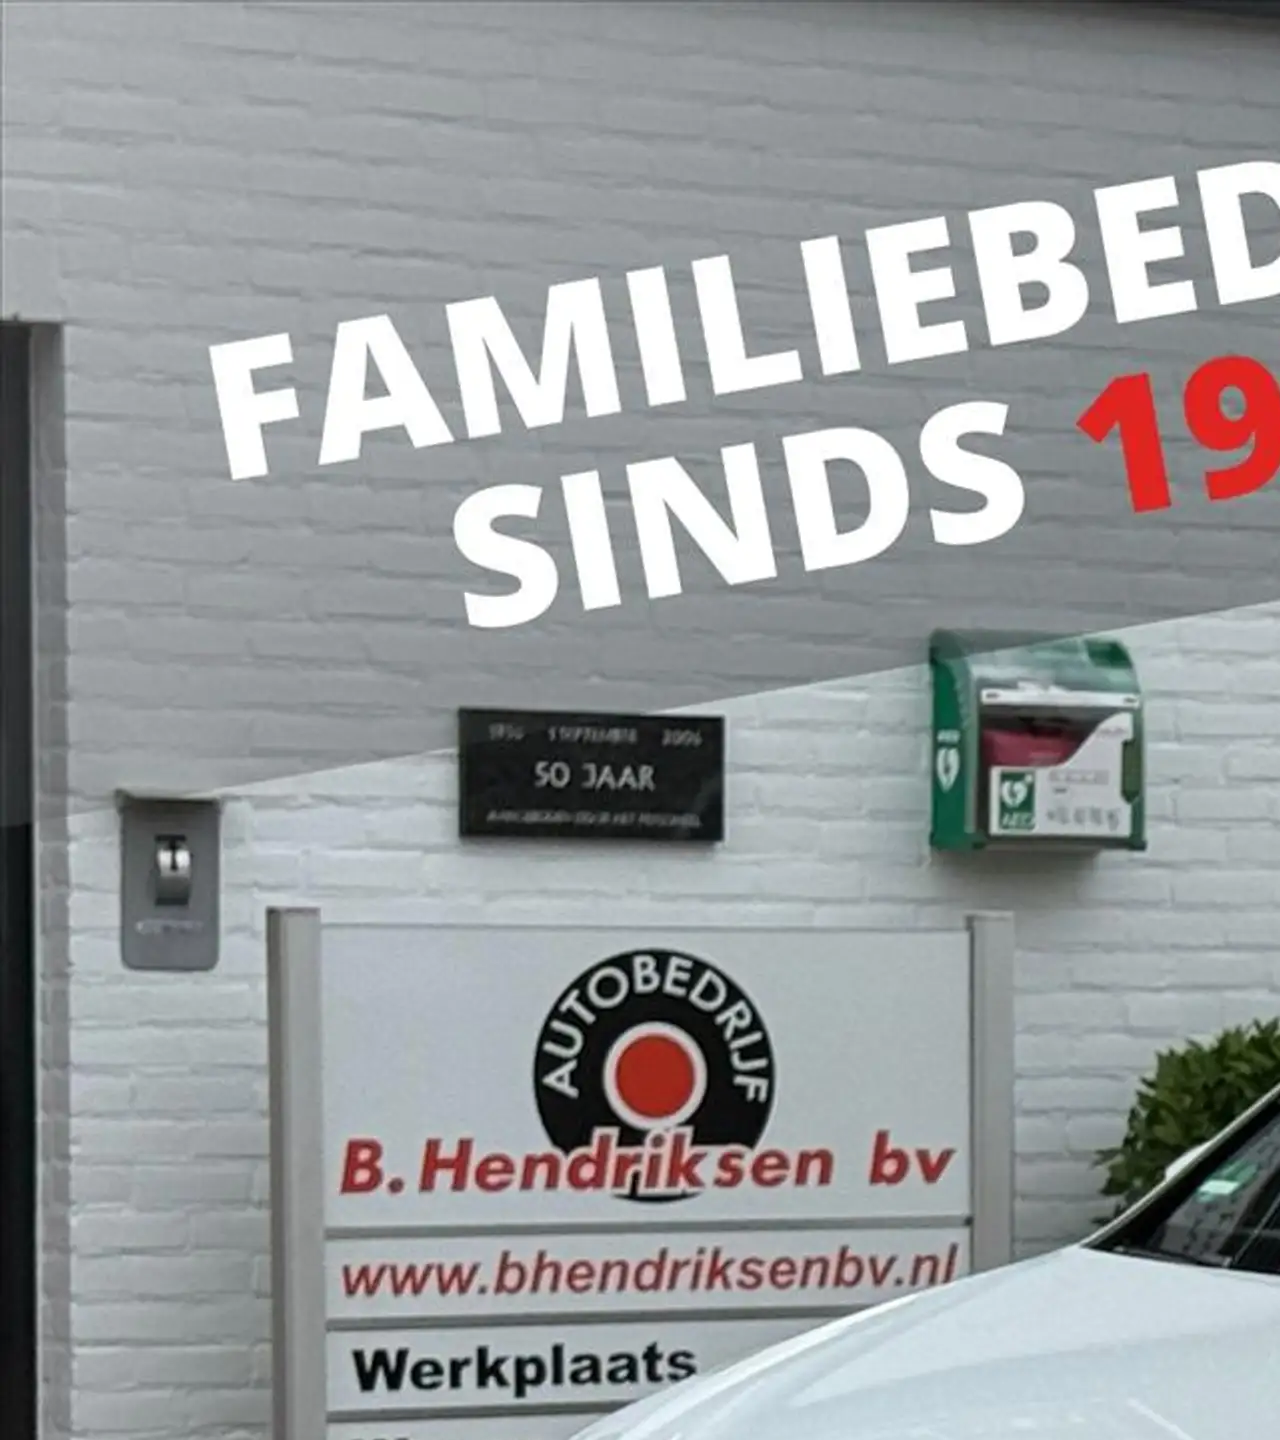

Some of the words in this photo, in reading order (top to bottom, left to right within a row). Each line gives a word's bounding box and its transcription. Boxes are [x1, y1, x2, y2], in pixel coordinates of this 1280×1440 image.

[533, 760, 571, 788] 50
[580, 762, 656, 791] JAAR
[542, 955, 768, 1102] AUTOBEDRIJF
[868, 1131, 957, 1185] bv
[342, 1243, 959, 1297] www.bhendriksenbv.nl
[353, 1342, 698, 1399] Werkplaats
